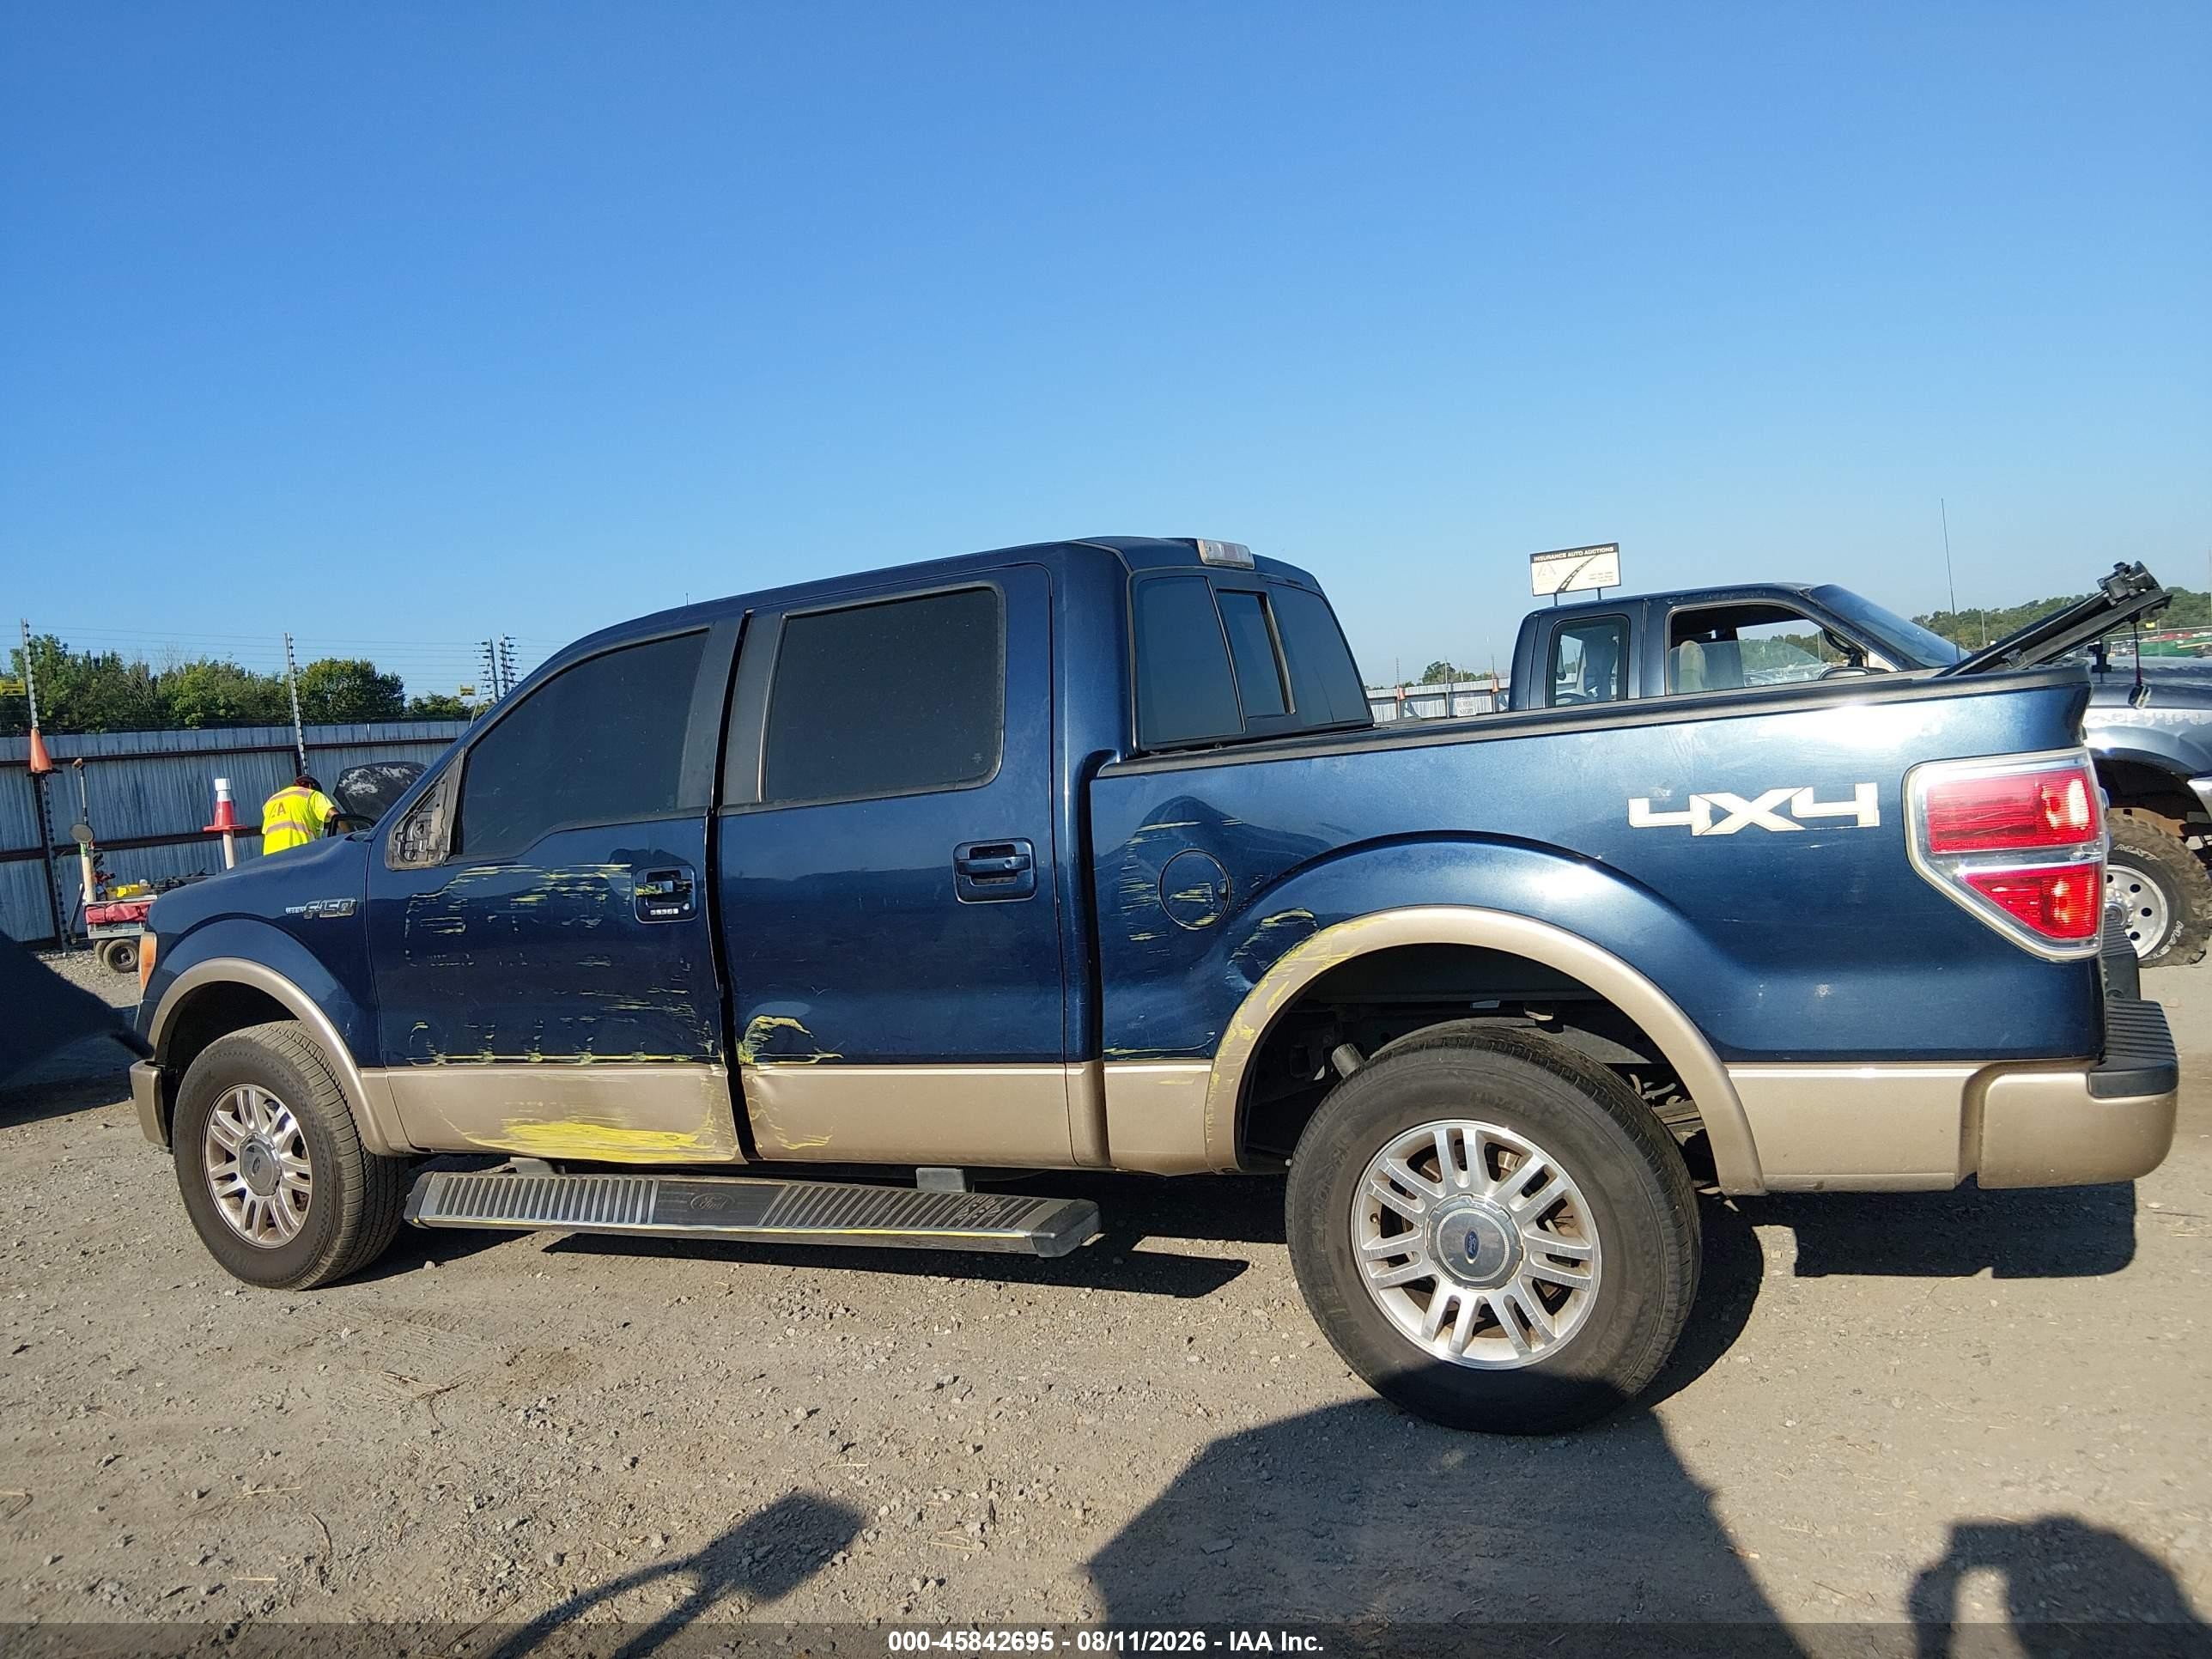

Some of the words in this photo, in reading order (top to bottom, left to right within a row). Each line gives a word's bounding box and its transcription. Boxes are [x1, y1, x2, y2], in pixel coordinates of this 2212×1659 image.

[1534, 552, 1566, 562] INSURANCE
[1584, 547, 1613, 556] AUCTIONS
[2113, 843, 2161, 861] MXT
